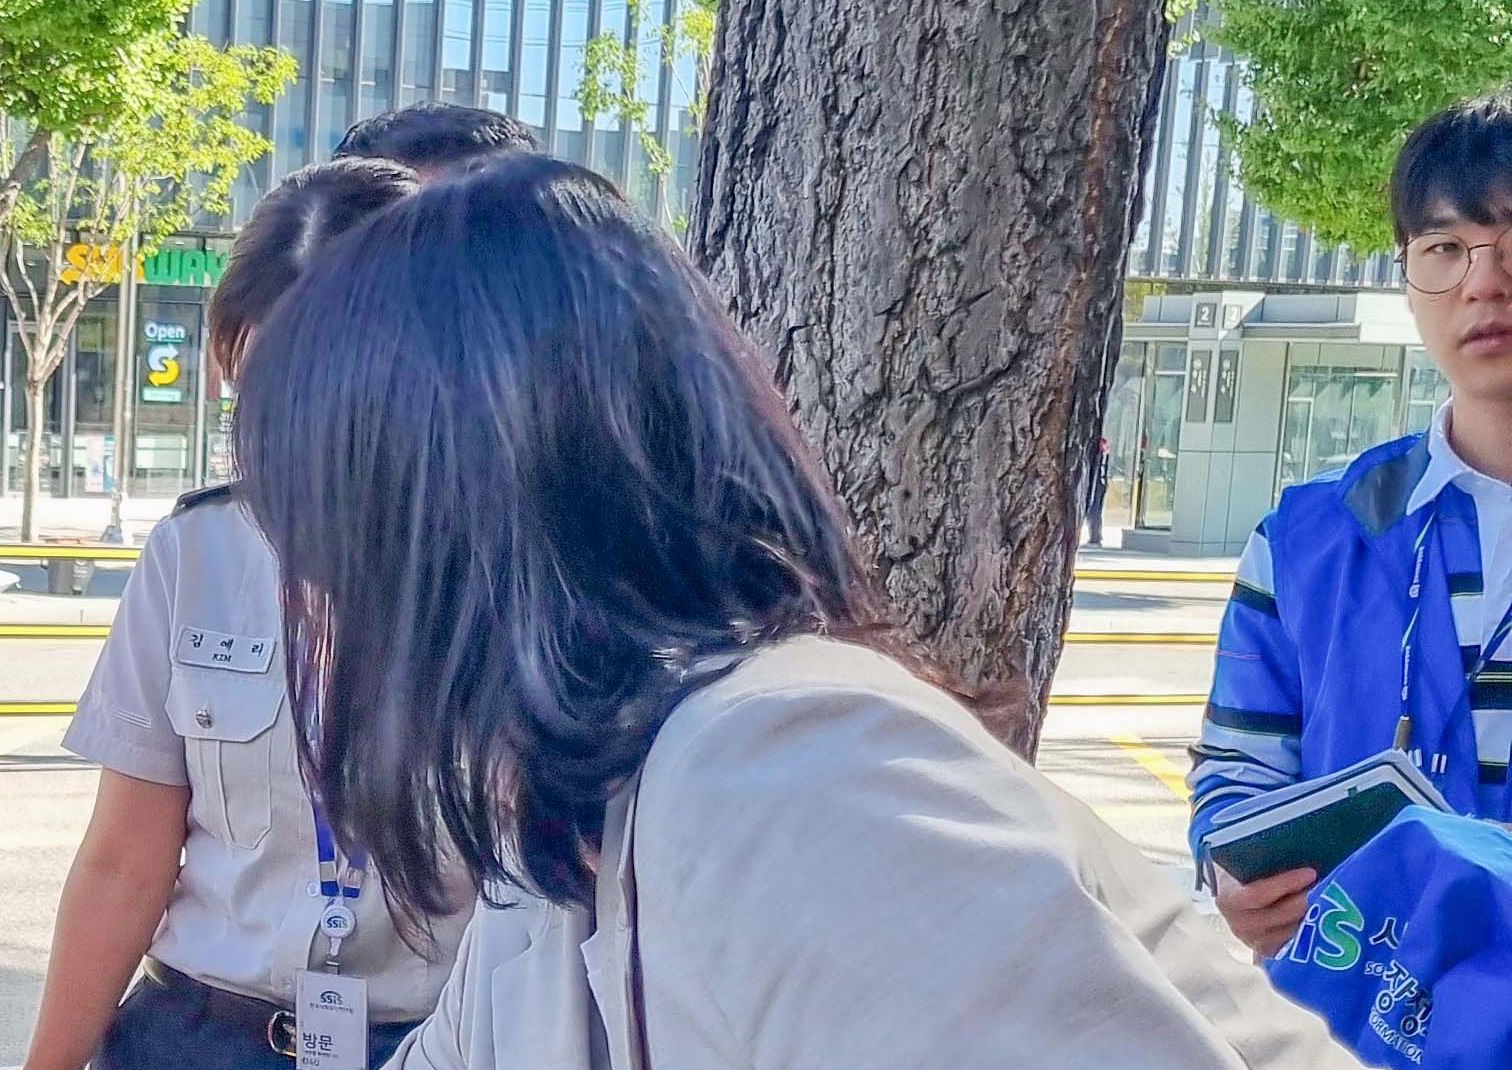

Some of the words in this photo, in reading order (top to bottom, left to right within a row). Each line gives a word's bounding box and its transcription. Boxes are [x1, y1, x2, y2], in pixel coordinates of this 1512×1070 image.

[1200, 306, 1210, 321] 2
[145, 322, 186, 342] Open
[212, 653, 232, 662] KIM
[302, 1032, 334, 1052] 방문
